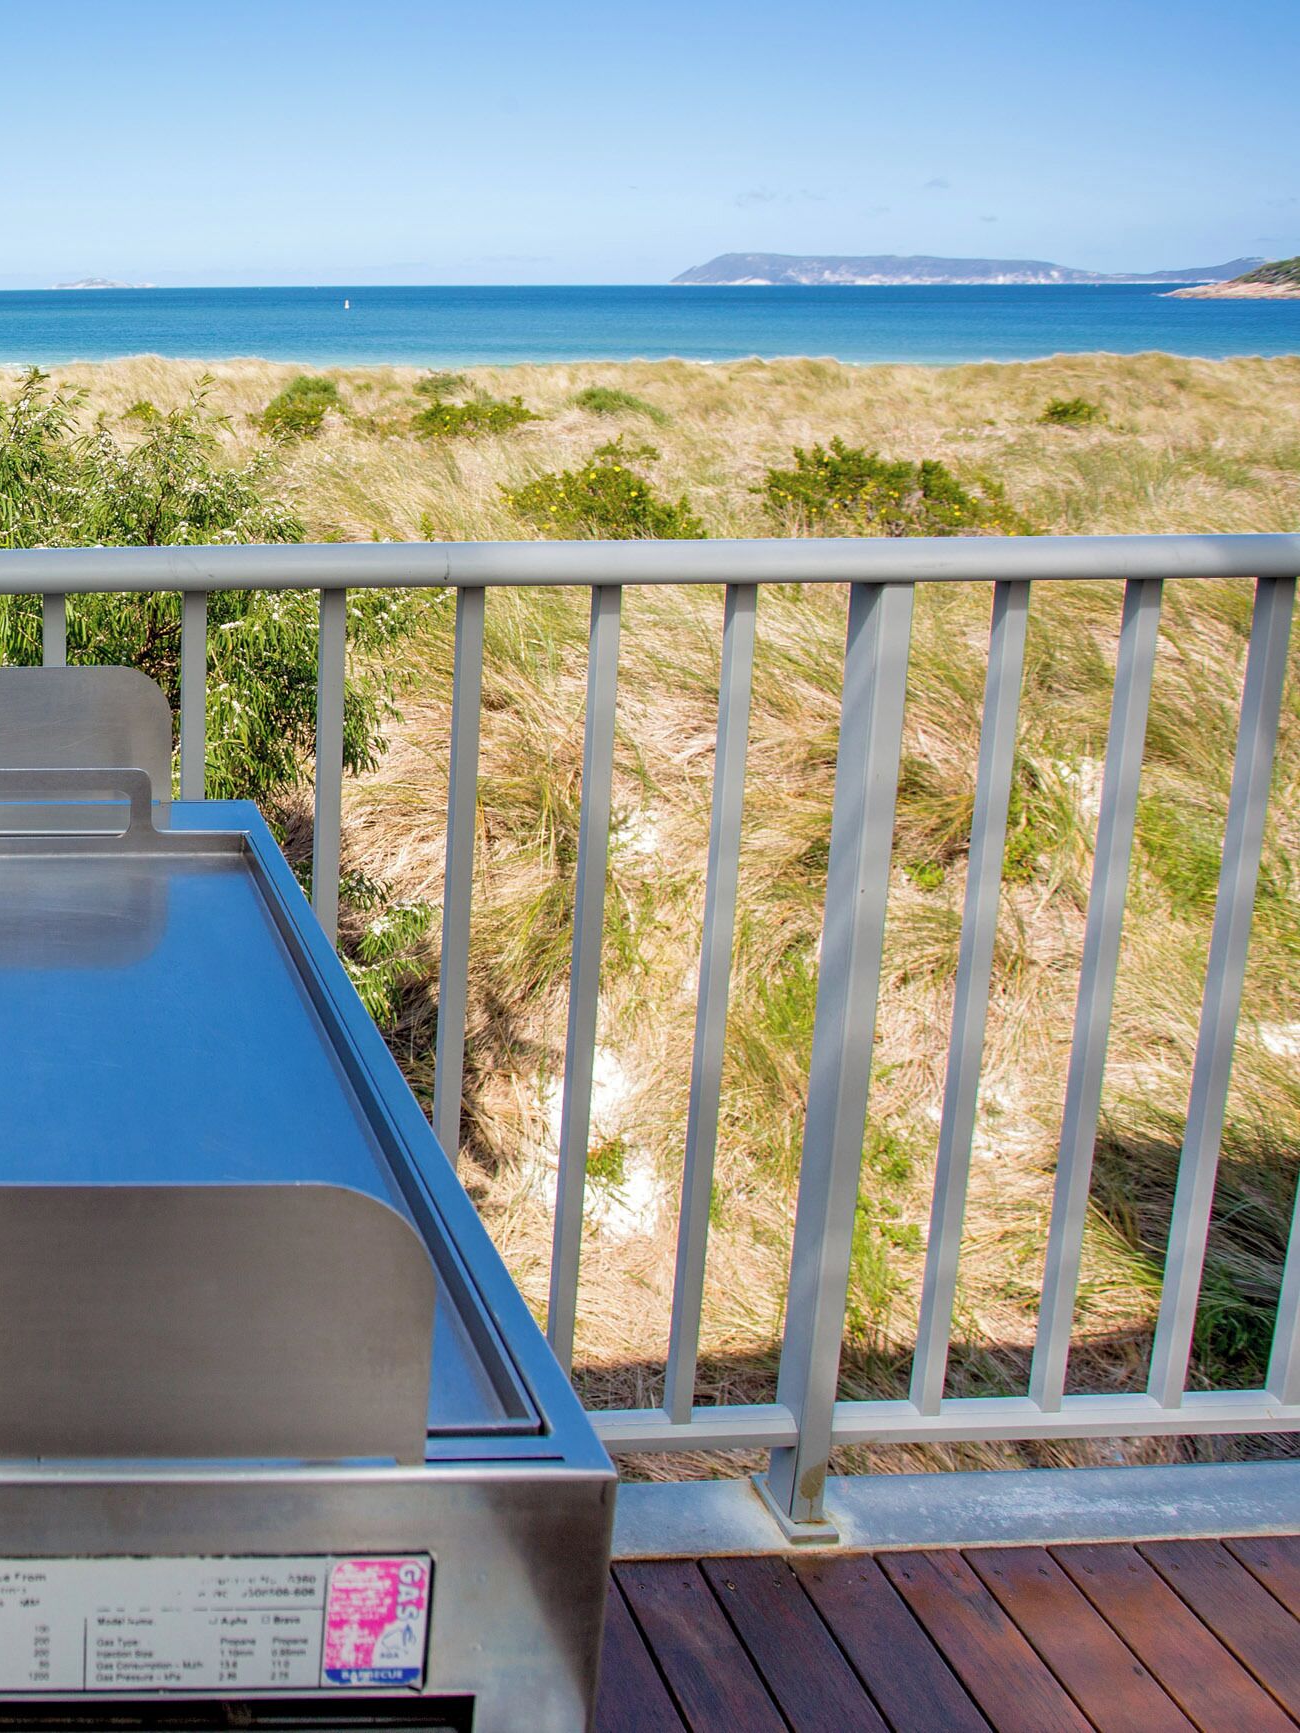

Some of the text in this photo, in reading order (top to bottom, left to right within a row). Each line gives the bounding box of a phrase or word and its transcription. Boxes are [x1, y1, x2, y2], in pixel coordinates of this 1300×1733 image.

[396, 1564, 423, 1620] GAS
[220, 1636, 256, 1646] Propane
[273, 1635, 309, 1646] Propane
[96, 1661, 114, 1671] Gas
[96, 1673, 113, 1683] Gas
